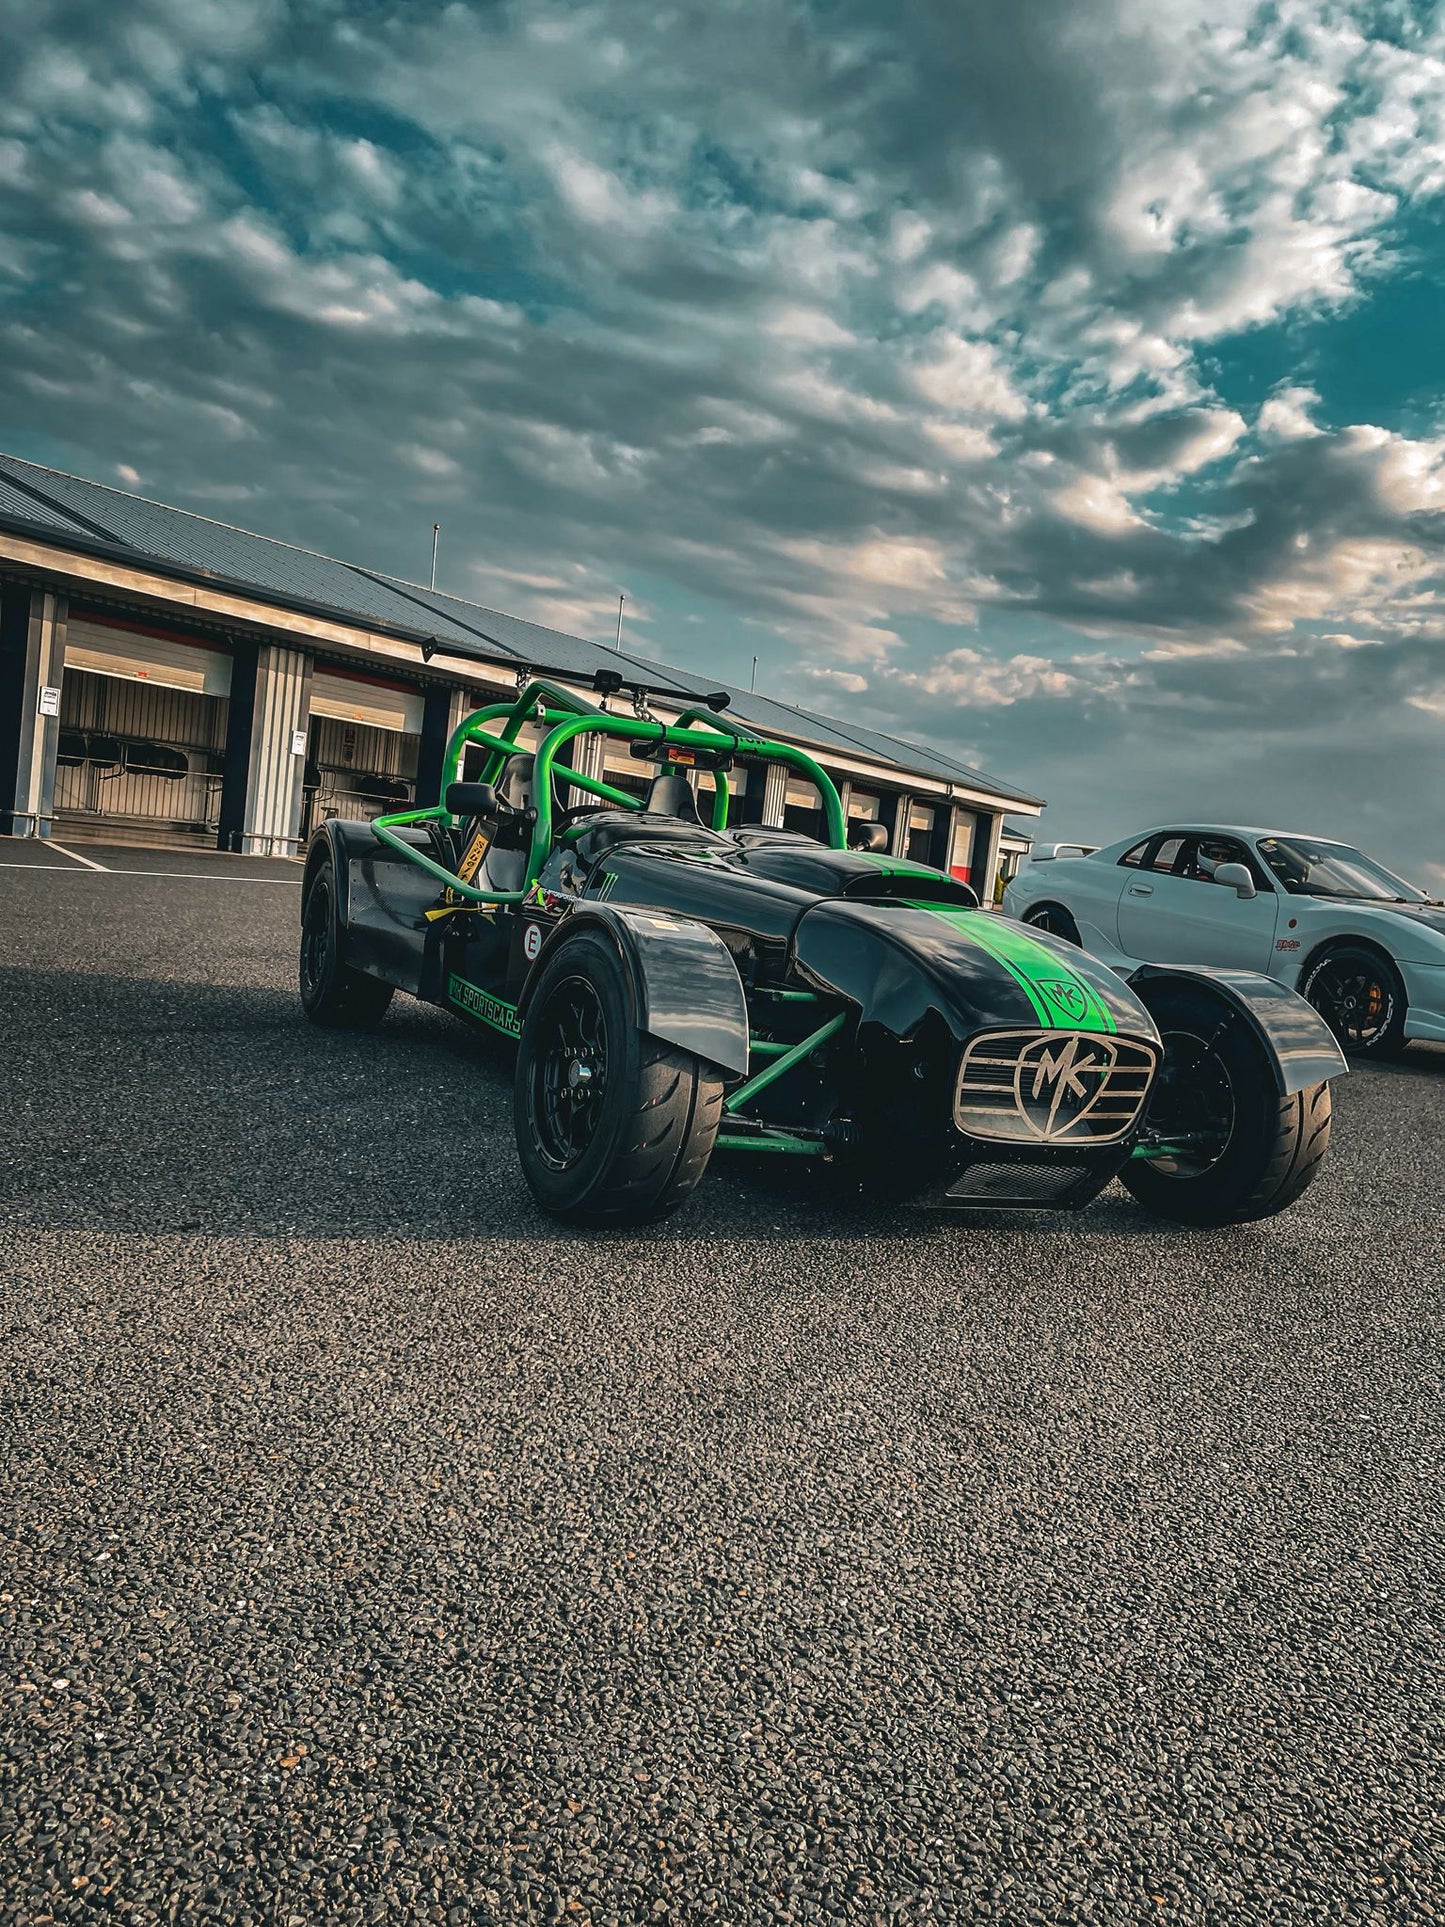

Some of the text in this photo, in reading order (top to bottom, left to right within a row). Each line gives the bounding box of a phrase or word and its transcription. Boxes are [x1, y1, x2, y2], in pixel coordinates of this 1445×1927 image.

[528, 930, 538, 954] E
[463, 987, 521, 1034] SPORTSCARS
[1048, 983, 1083, 1009] MK
[1032, 1040, 1097, 1111] MK
